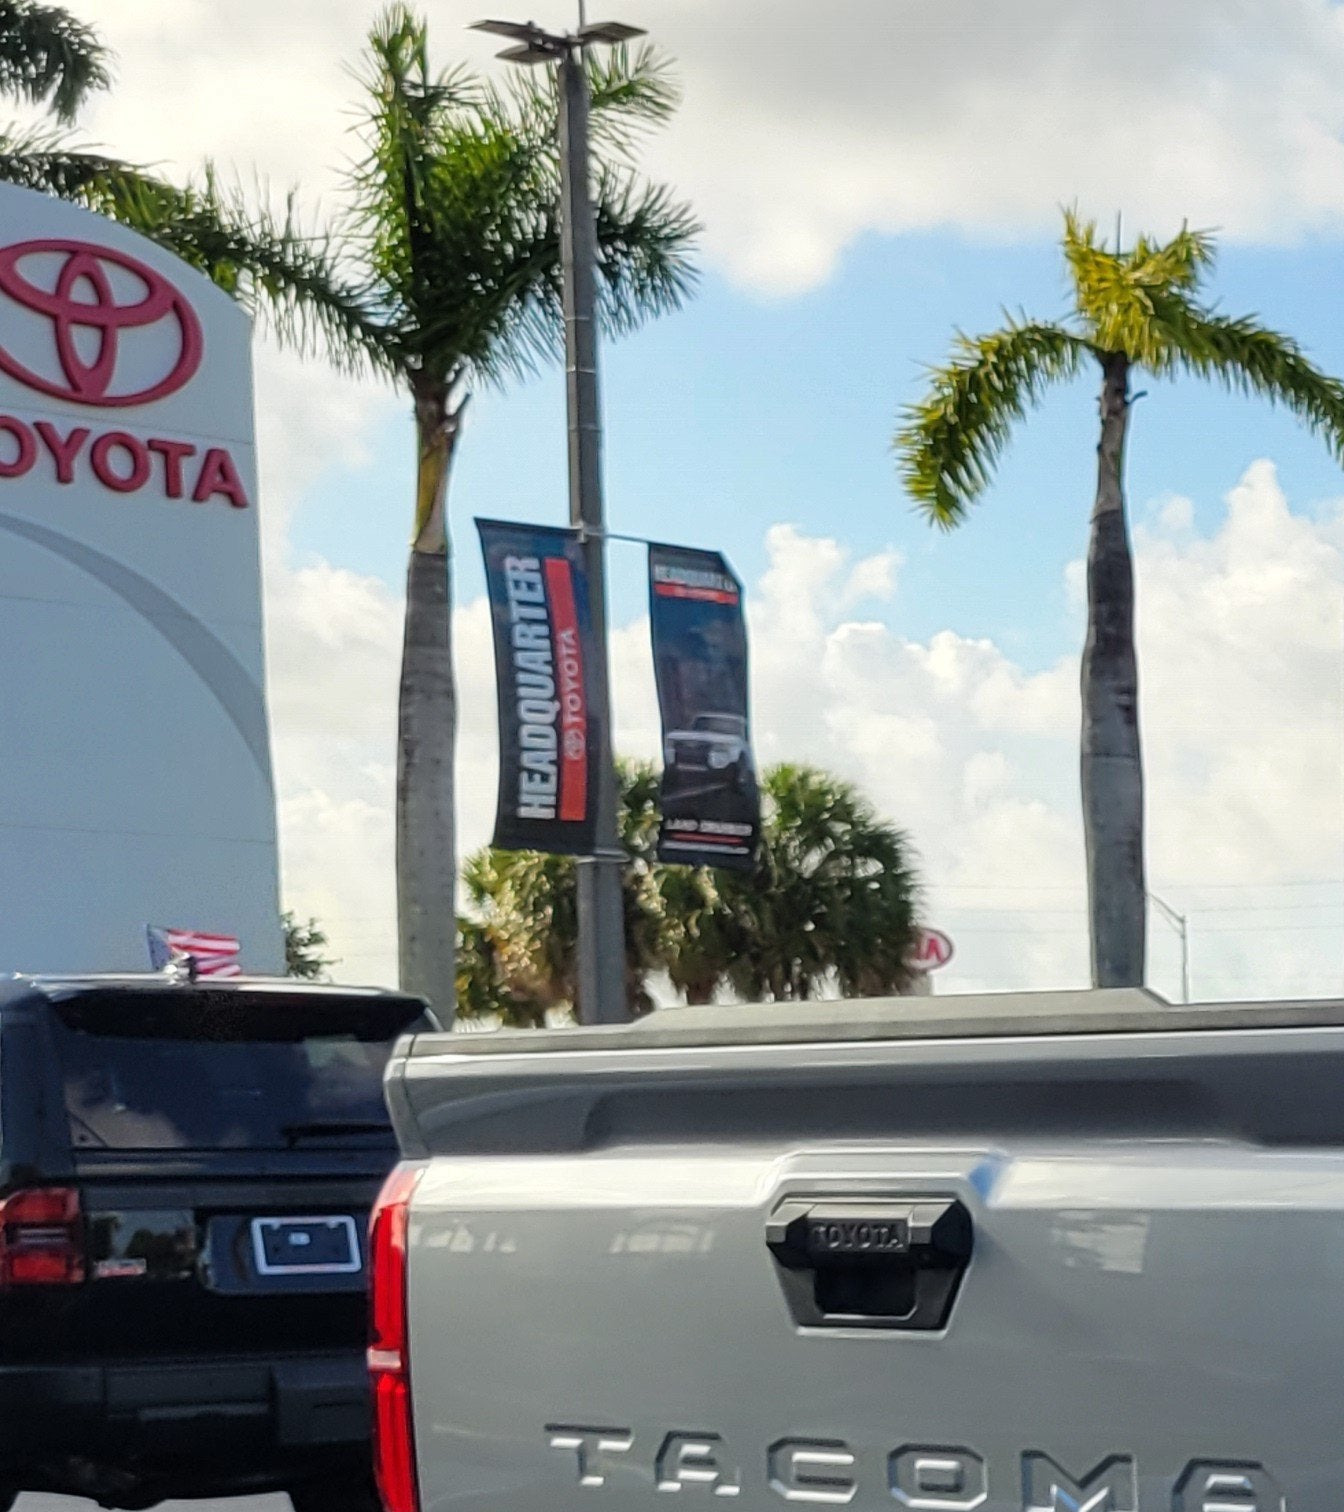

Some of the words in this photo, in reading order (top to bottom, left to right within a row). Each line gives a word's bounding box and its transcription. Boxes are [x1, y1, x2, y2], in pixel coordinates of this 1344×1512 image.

[0, 415, 248, 509] OYOTA
[504, 556, 560, 819] HEADQUARTER
[559, 629, 583, 723] TOYOTA
[812, 1221, 904, 1249] TOYOTA
